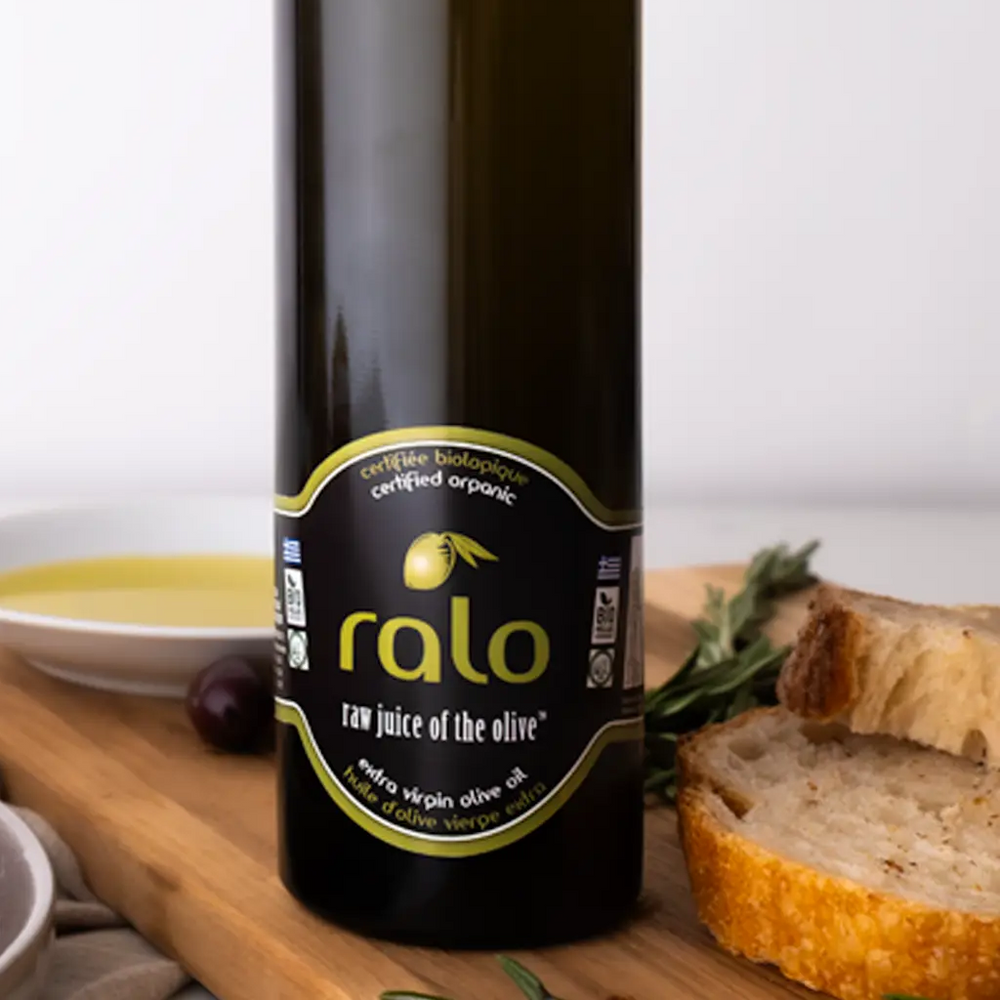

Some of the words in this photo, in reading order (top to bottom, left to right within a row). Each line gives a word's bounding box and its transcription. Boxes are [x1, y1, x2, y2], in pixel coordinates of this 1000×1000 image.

[360, 451, 429, 480] certifiée
[370, 470, 443, 500] certified
[339, 596, 550, 684] ralo
[342, 702, 372, 730] raw
[376, 703, 423, 739] juice
[428, 709, 450, 741] of
[454, 711, 486, 742] the
[342, 764, 379, 803] huile
[358, 758, 398, 794] extra
[459, 785, 502, 809] olive
[505, 766, 529, 789] oil
